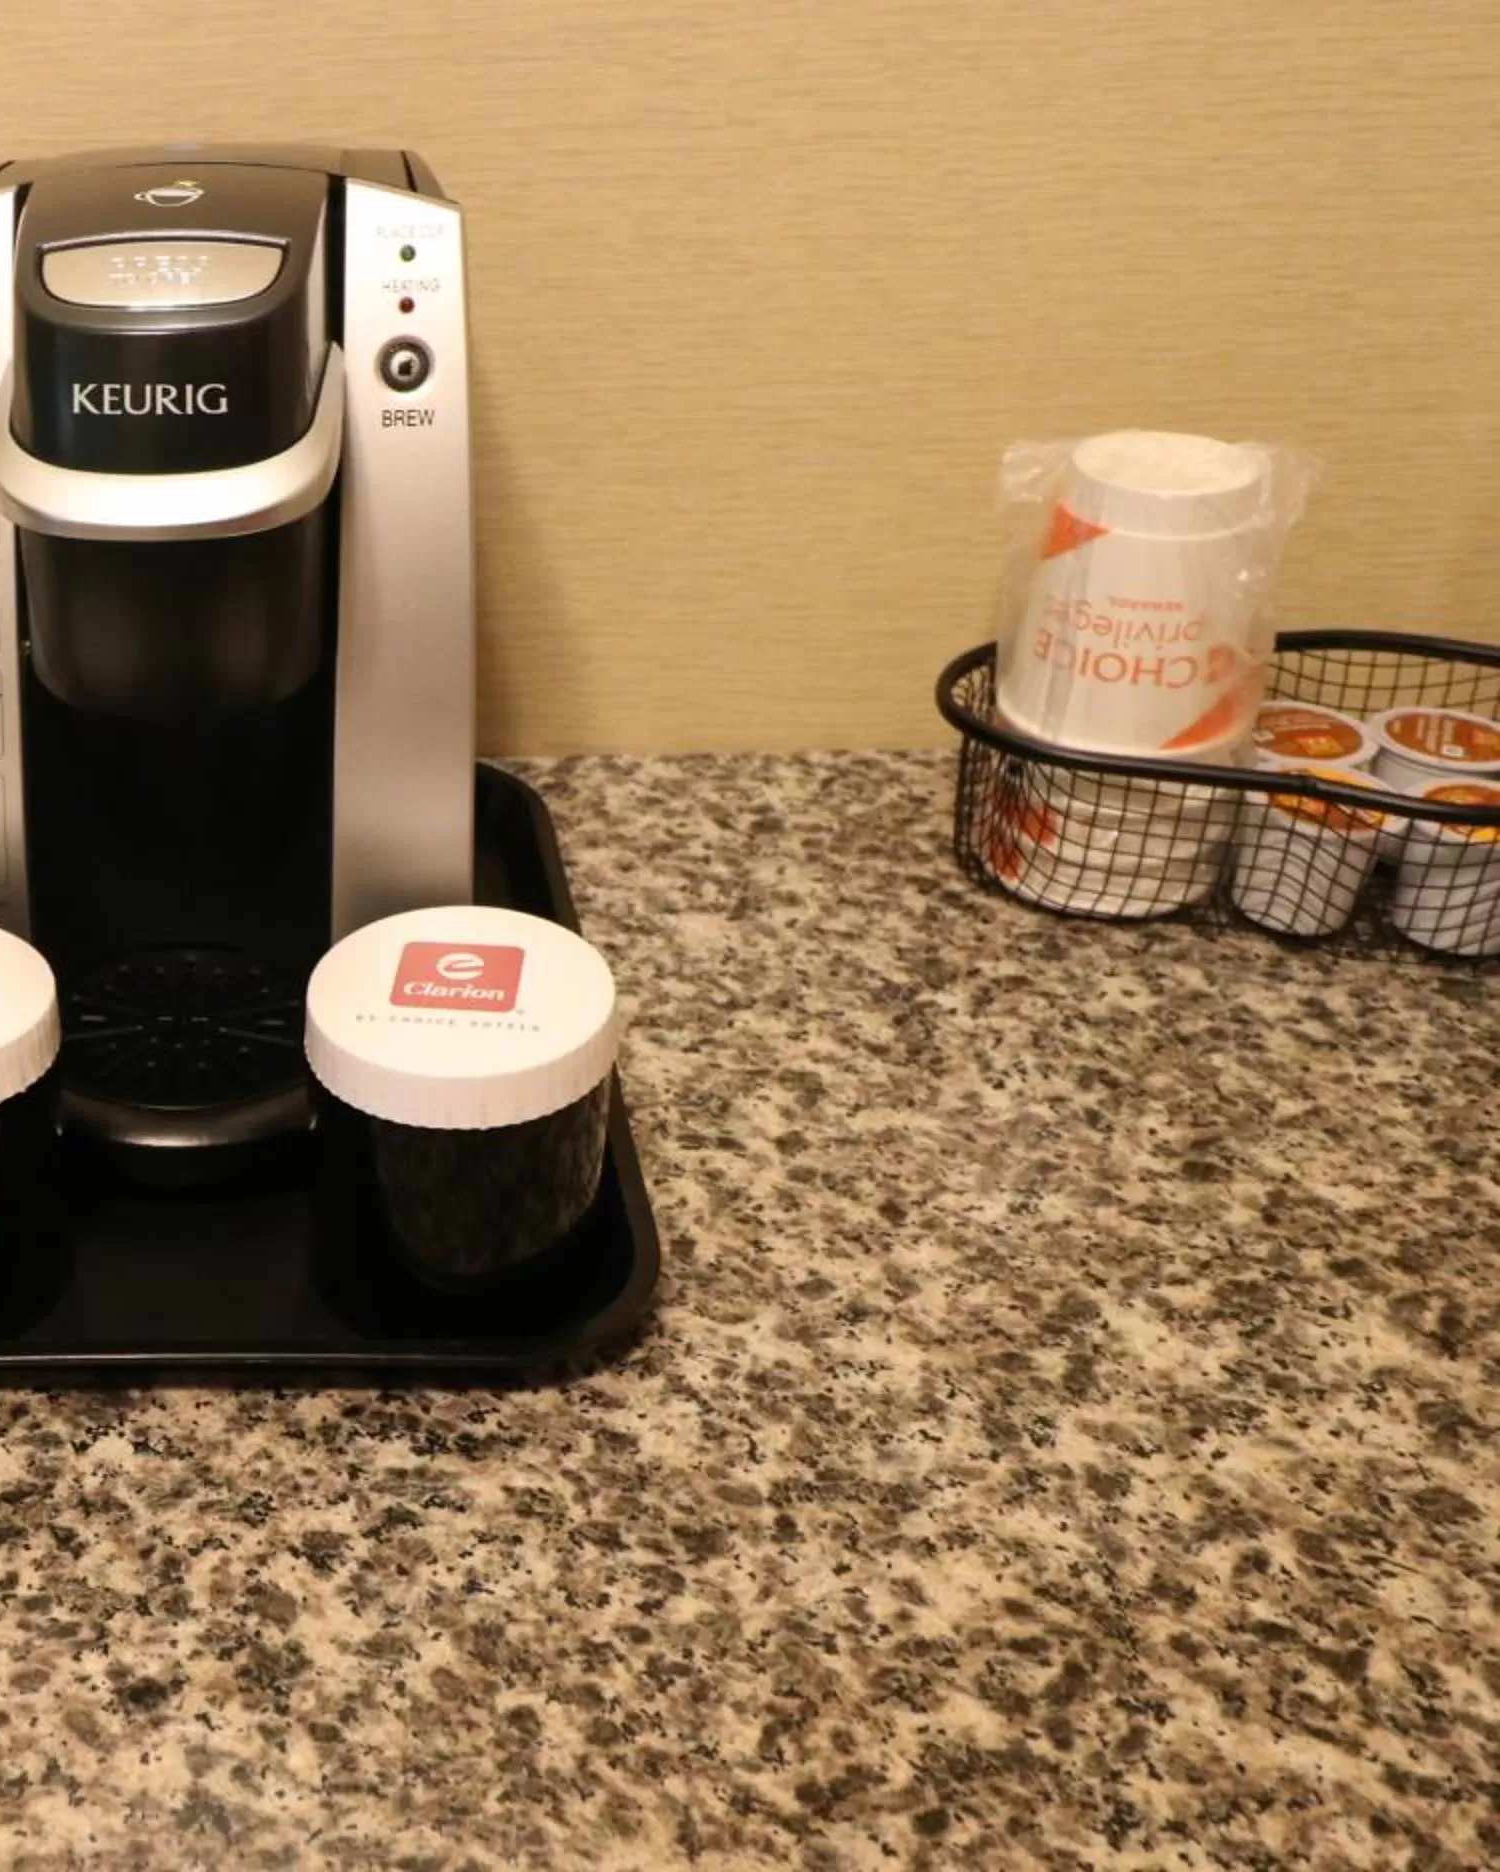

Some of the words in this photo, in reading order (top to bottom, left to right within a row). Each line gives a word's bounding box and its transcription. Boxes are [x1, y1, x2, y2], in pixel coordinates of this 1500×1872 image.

[71, 382, 230, 416] KEURIG
[381, 409, 436, 428] BREW
[1032, 627, 1199, 690] CHOICE
[402, 980, 506, 1002] Clarion
